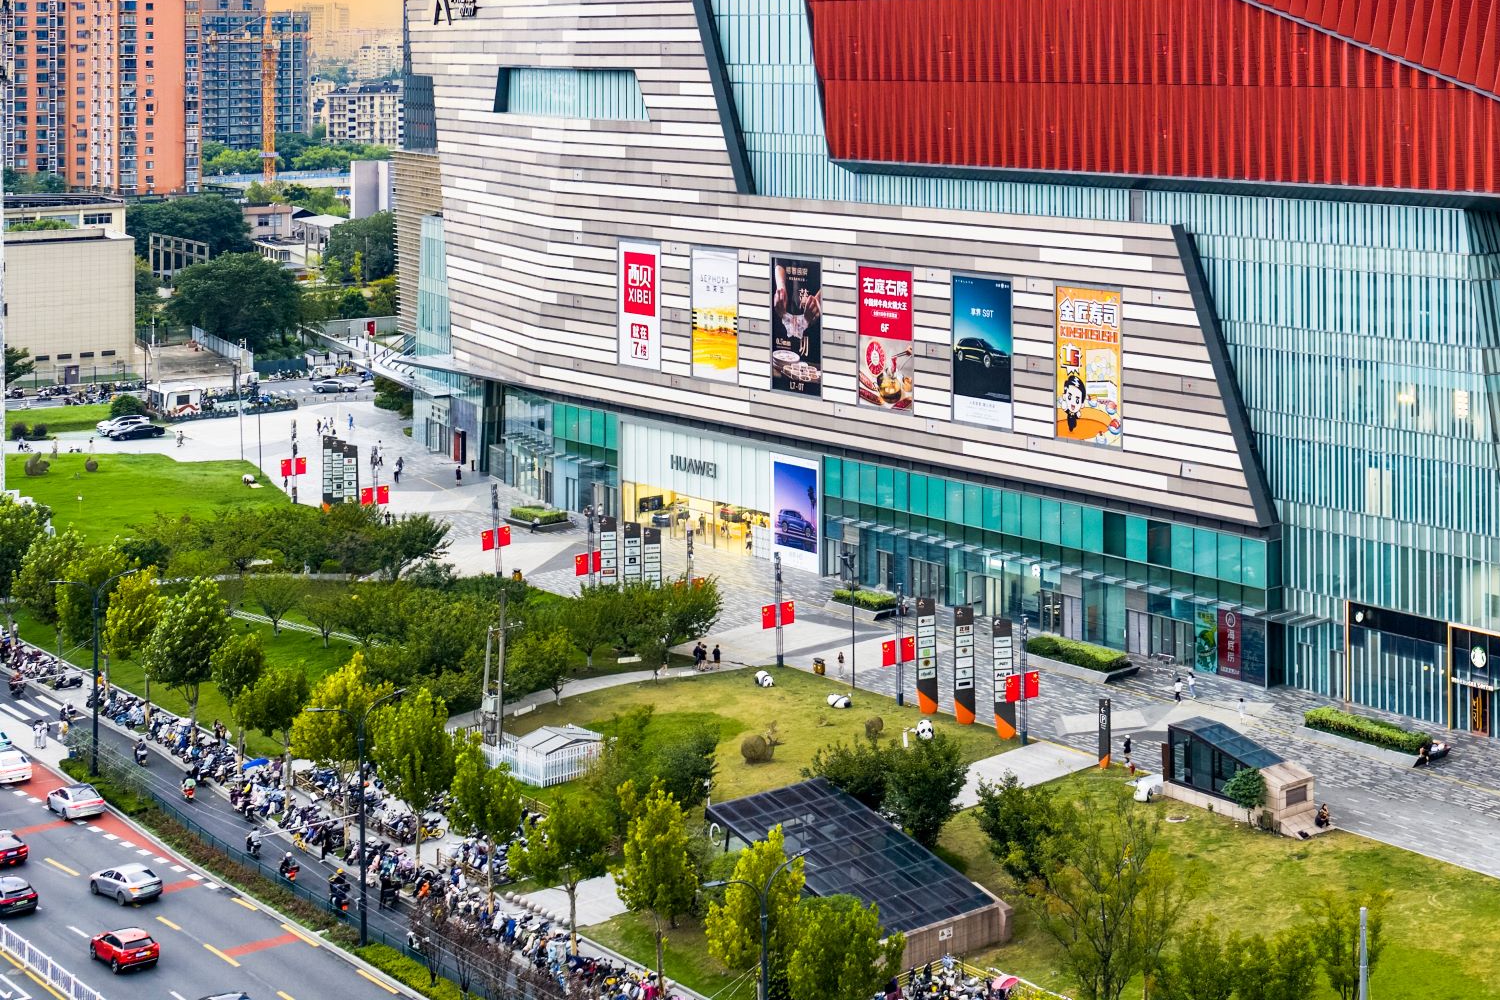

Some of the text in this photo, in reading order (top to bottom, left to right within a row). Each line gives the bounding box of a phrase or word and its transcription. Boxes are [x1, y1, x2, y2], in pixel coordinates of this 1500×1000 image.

[628, 264, 653, 288] 西贝
[863, 277, 909, 297] 左庭右院
[628, 287, 652, 305] XIBEI
[982, 308, 994, 318] S9T
[1059, 297, 1118, 328] 金匠寿司
[632, 325, 648, 340] 就在
[880, 323, 890, 333] 6F
[1059, 326, 1119, 343] KINSHOSUSHI
[632, 341, 647, 357] 7楼
[670, 455, 717, 479] HUAWEI
